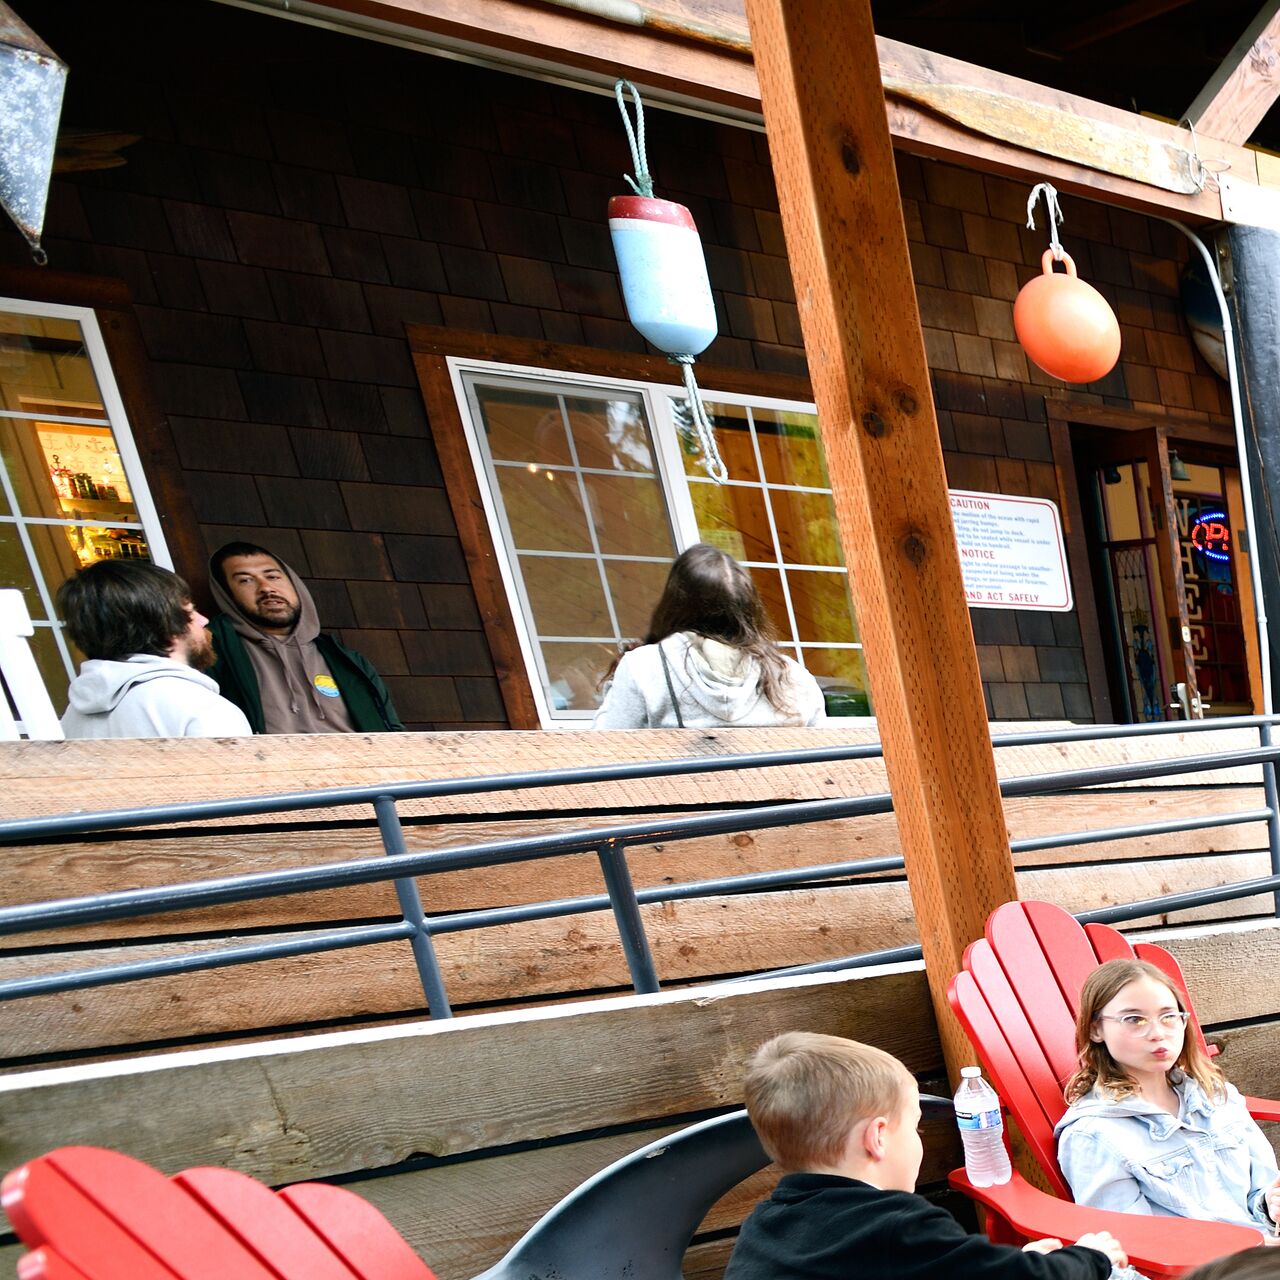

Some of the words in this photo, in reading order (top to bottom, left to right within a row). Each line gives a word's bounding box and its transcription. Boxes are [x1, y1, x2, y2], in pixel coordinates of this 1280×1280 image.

[951, 498, 990, 510] CAUTION
[961, 549, 995, 559] NOTICE
[988, 591, 1004, 601] ACT
[1009, 592, 1040, 603] SAFELY
